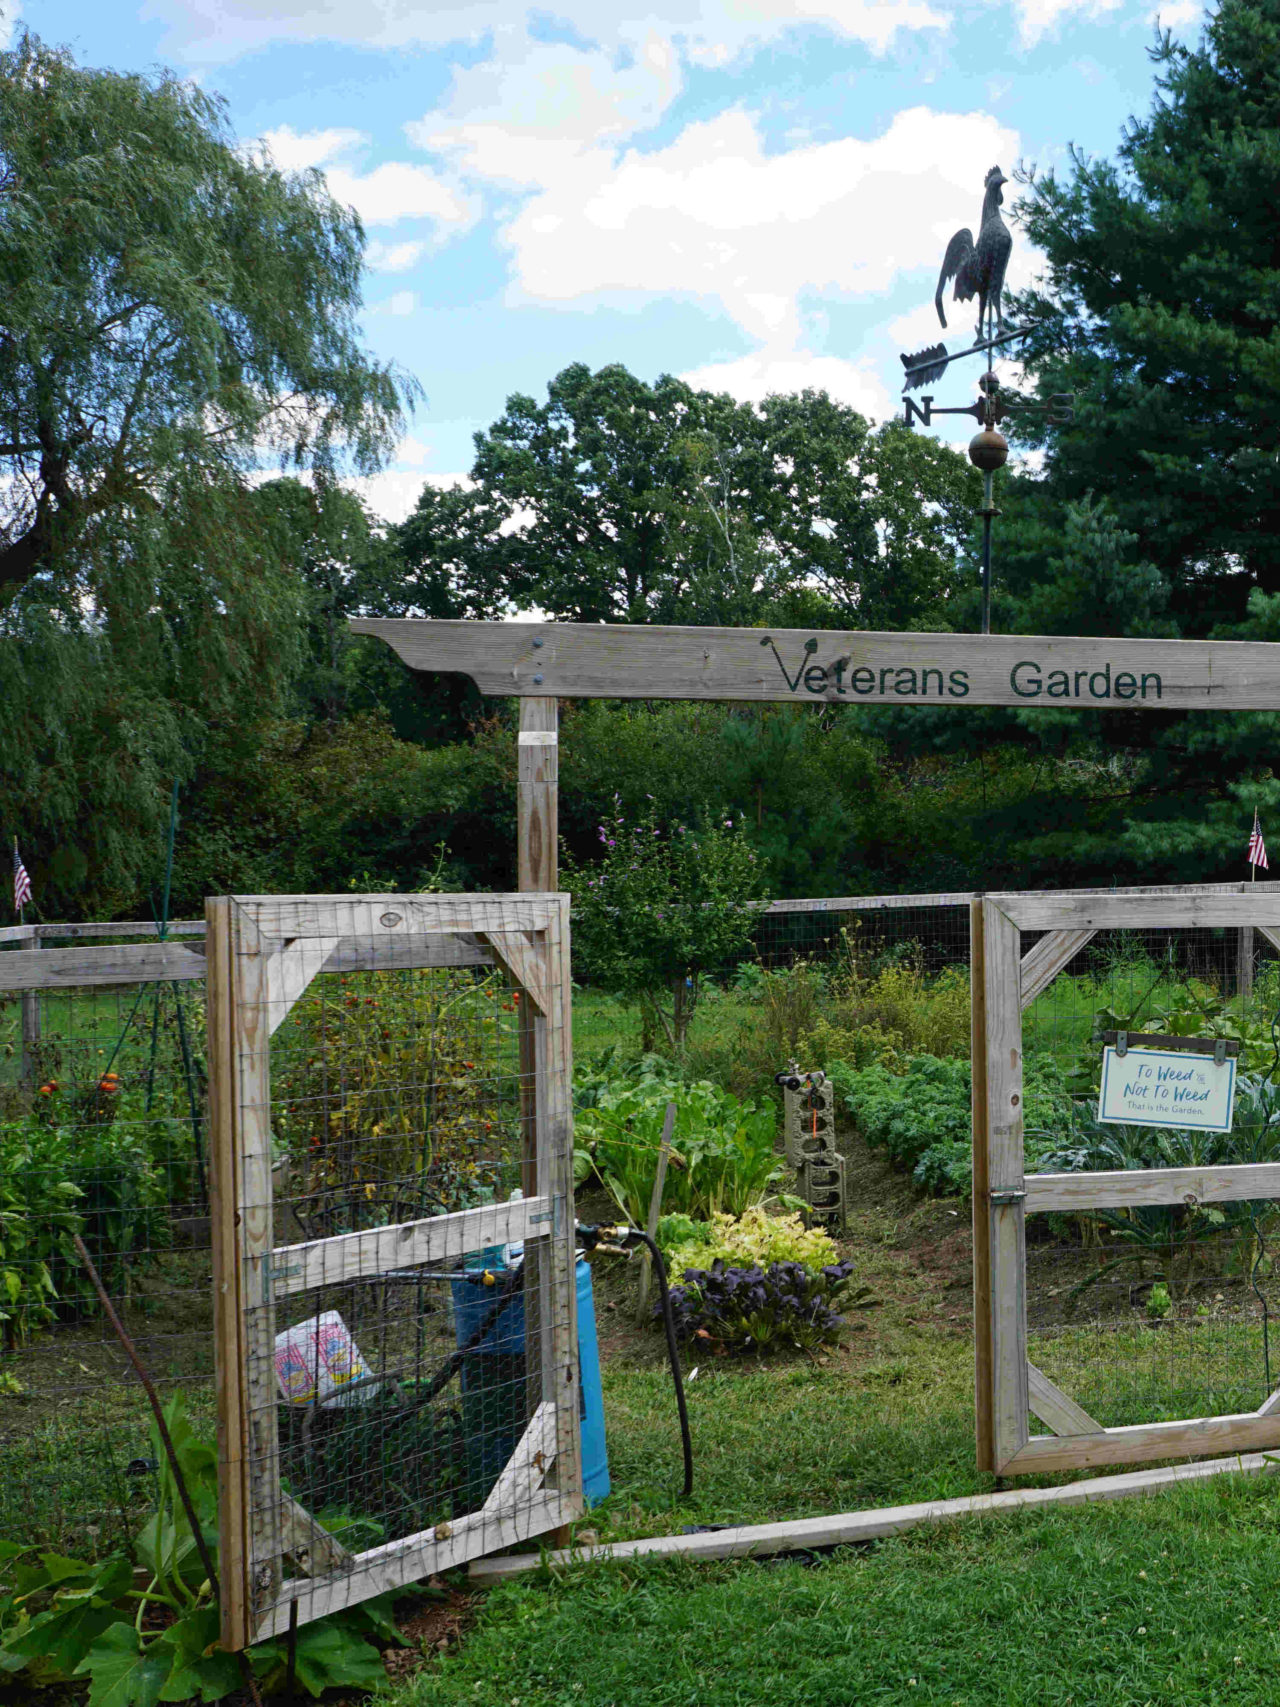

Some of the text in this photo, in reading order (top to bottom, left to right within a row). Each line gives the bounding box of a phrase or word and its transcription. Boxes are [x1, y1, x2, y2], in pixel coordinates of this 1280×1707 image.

[902, 396, 934, 427] N
[1047, 393, 1075, 425] S
[760, 636, 1163, 699] Veterans Garden
[1137, 1064, 1153, 1078] To
[1157, 1065, 1194, 1081] Weed
[1123, 1081, 1210, 1101] Not To Weed
[1128, 1100, 1145, 1110] That
[1156, 1103, 1169, 1112] the
